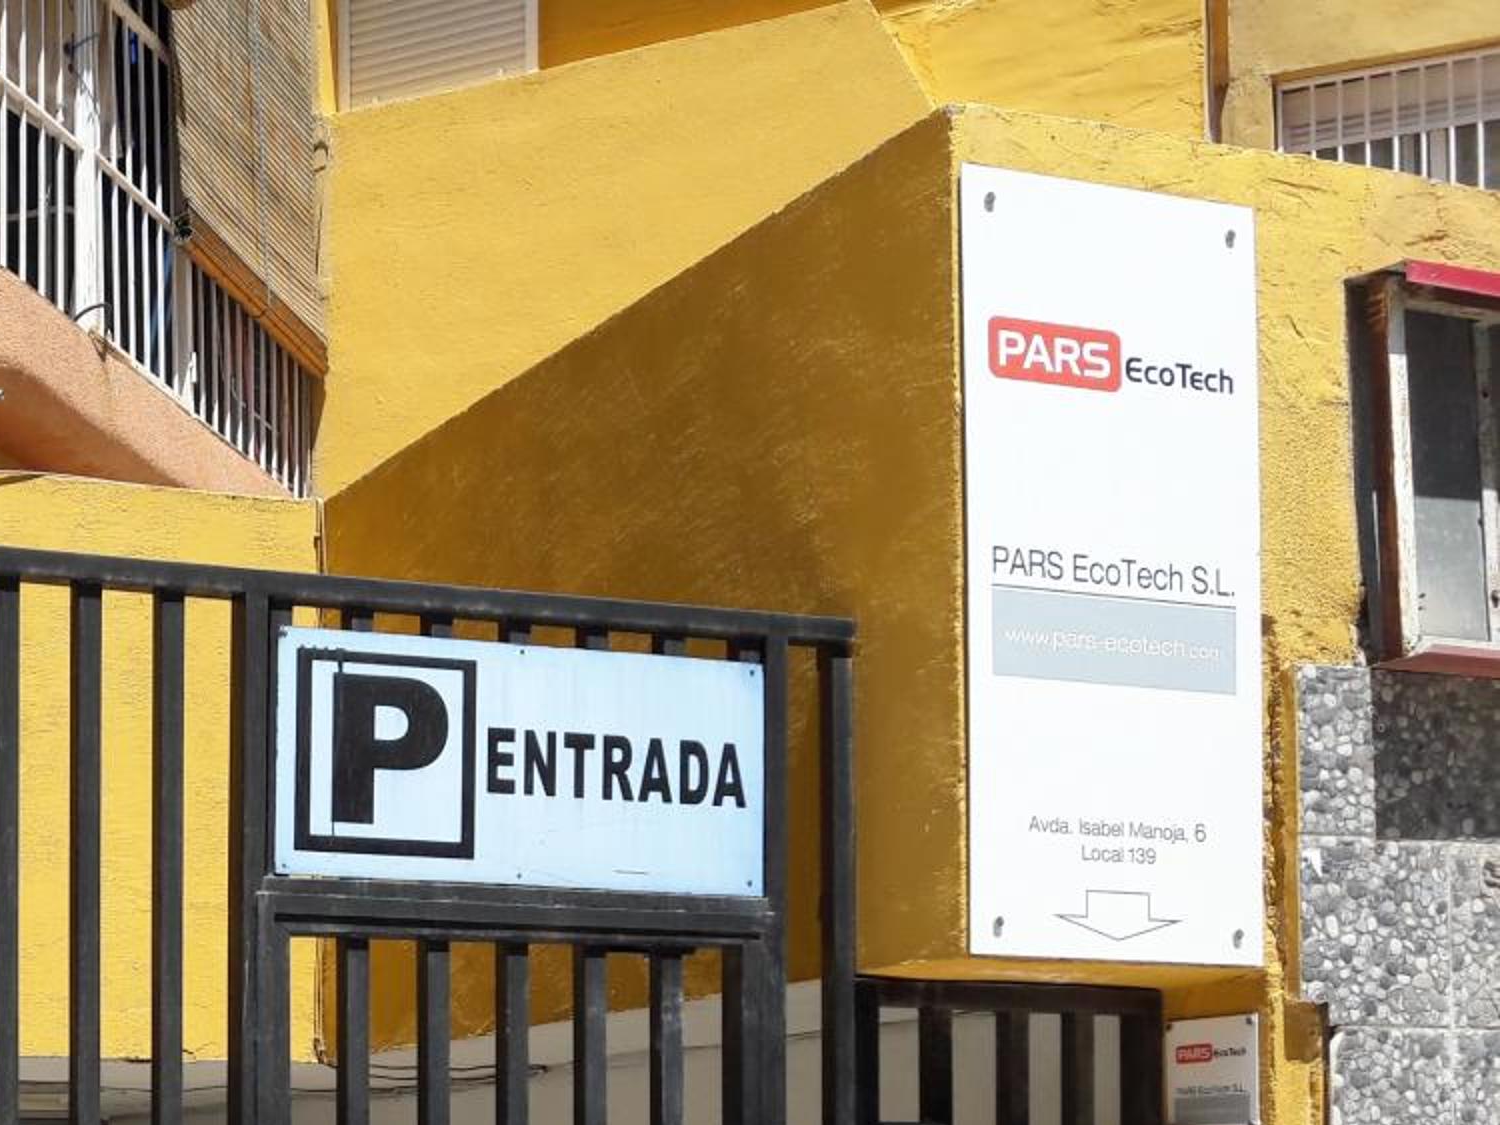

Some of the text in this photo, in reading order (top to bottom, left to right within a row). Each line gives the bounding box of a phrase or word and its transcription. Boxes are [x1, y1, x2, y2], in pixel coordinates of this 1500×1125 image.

[998, 329, 1234, 395] PARS EcoTech
[992, 545, 1235, 597] PARS EcoTech S.L.
[1003, 627, 1221, 660] www.pars-ecotech.com
[332, 672, 747, 825] P ENTRADA
[1028, 815, 1207, 844] Avda. Isabel Manoja, 6
[1081, 844, 1157, 865] Local 139
